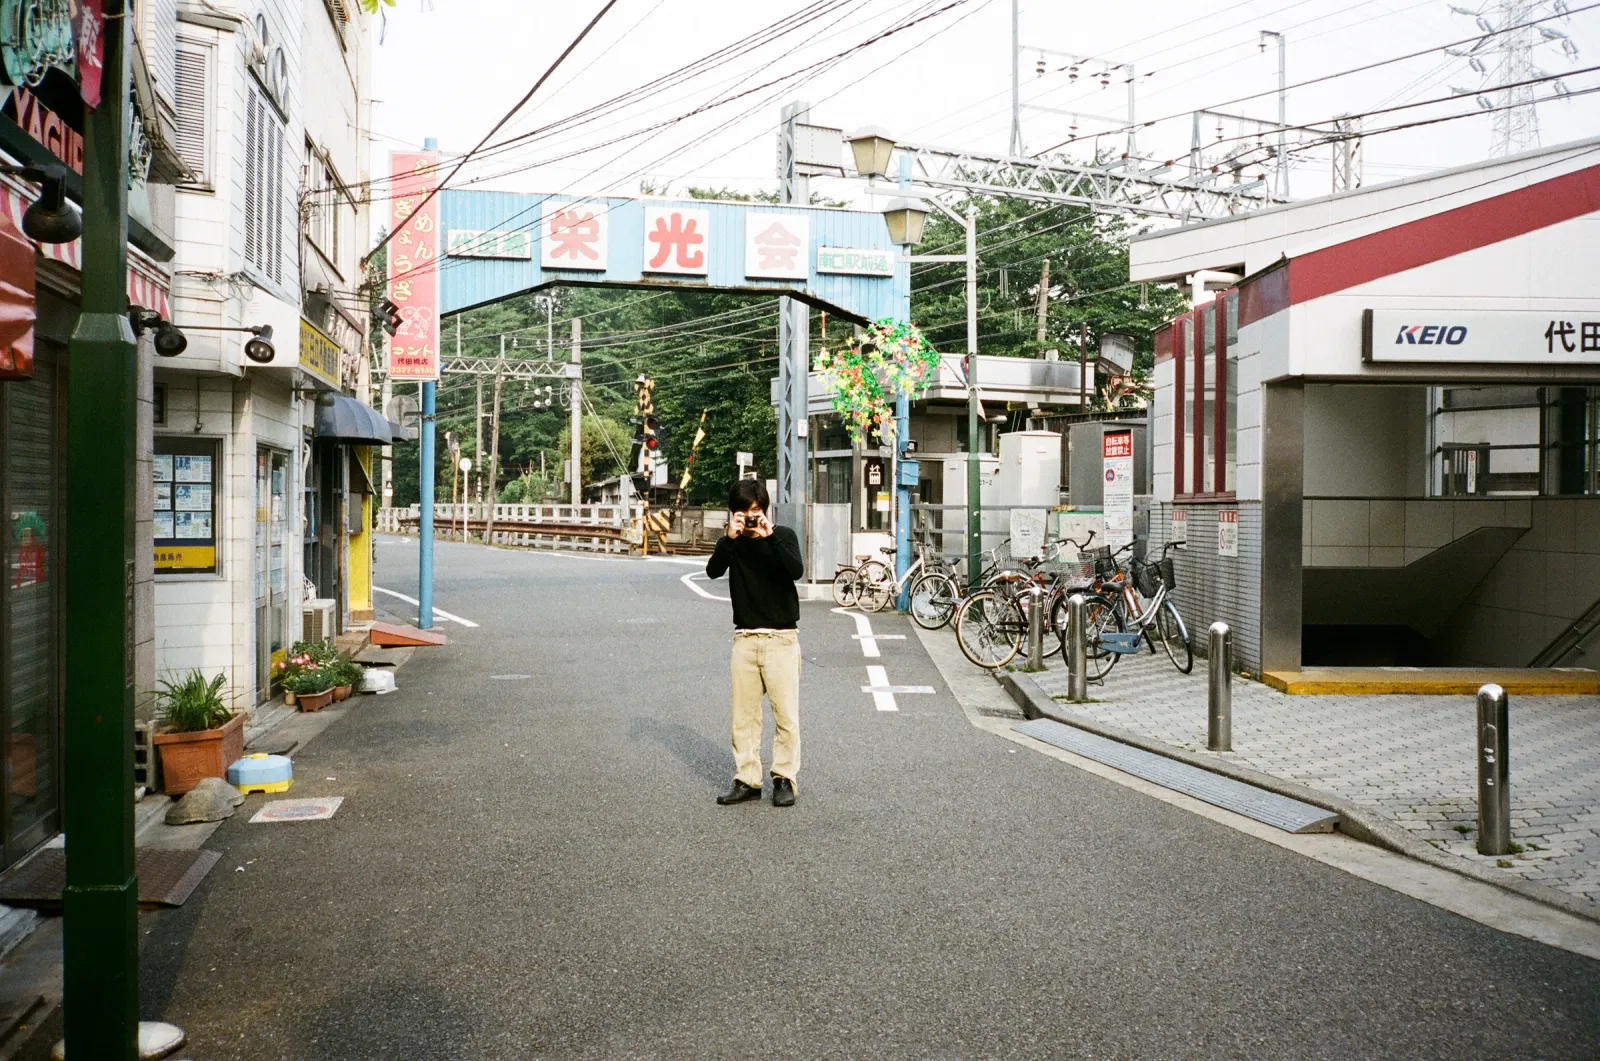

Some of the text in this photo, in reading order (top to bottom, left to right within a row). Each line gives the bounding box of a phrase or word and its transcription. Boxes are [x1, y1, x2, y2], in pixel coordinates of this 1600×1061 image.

[393, 199, 415, 302] ぎょうざ
[413, 158, 435, 260] らーめん
[1395, 325, 1468, 345] KEIO
